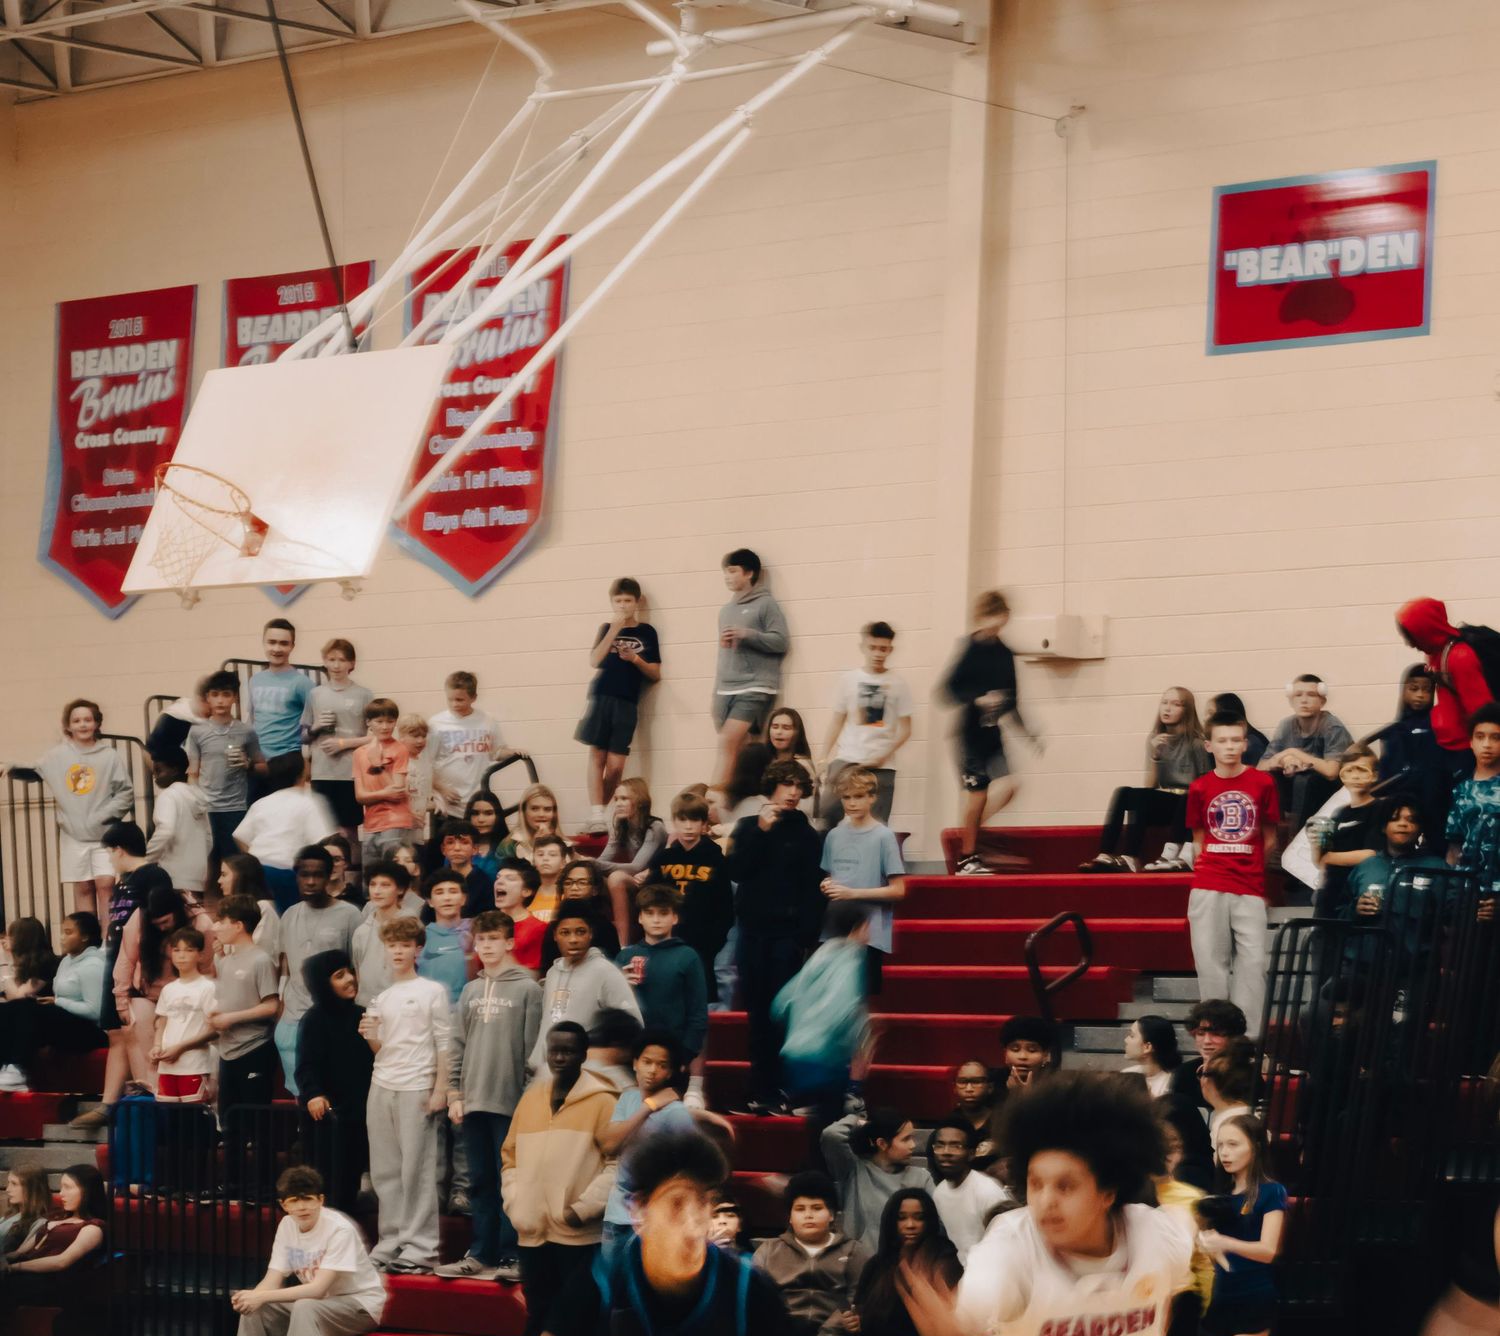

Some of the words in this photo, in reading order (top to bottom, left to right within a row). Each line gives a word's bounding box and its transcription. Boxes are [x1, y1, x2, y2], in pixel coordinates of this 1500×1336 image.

[1224, 229, 1420, 288] "BEAR"DEN
[237, 304, 338, 347] BEARD
[425, 311, 547, 369] ruins
[70, 338, 179, 379] BEARDEN
[69, 367, 176, 430] Bruins
[74, 431, 110, 450] Cross
[113, 425, 168, 446] Country
[464, 470, 487, 490] 1st
[488, 466, 532, 488] Place
[422, 511, 460, 535] Boys
[488, 505, 529, 527] Place
[451, 741, 496, 754] ATION
